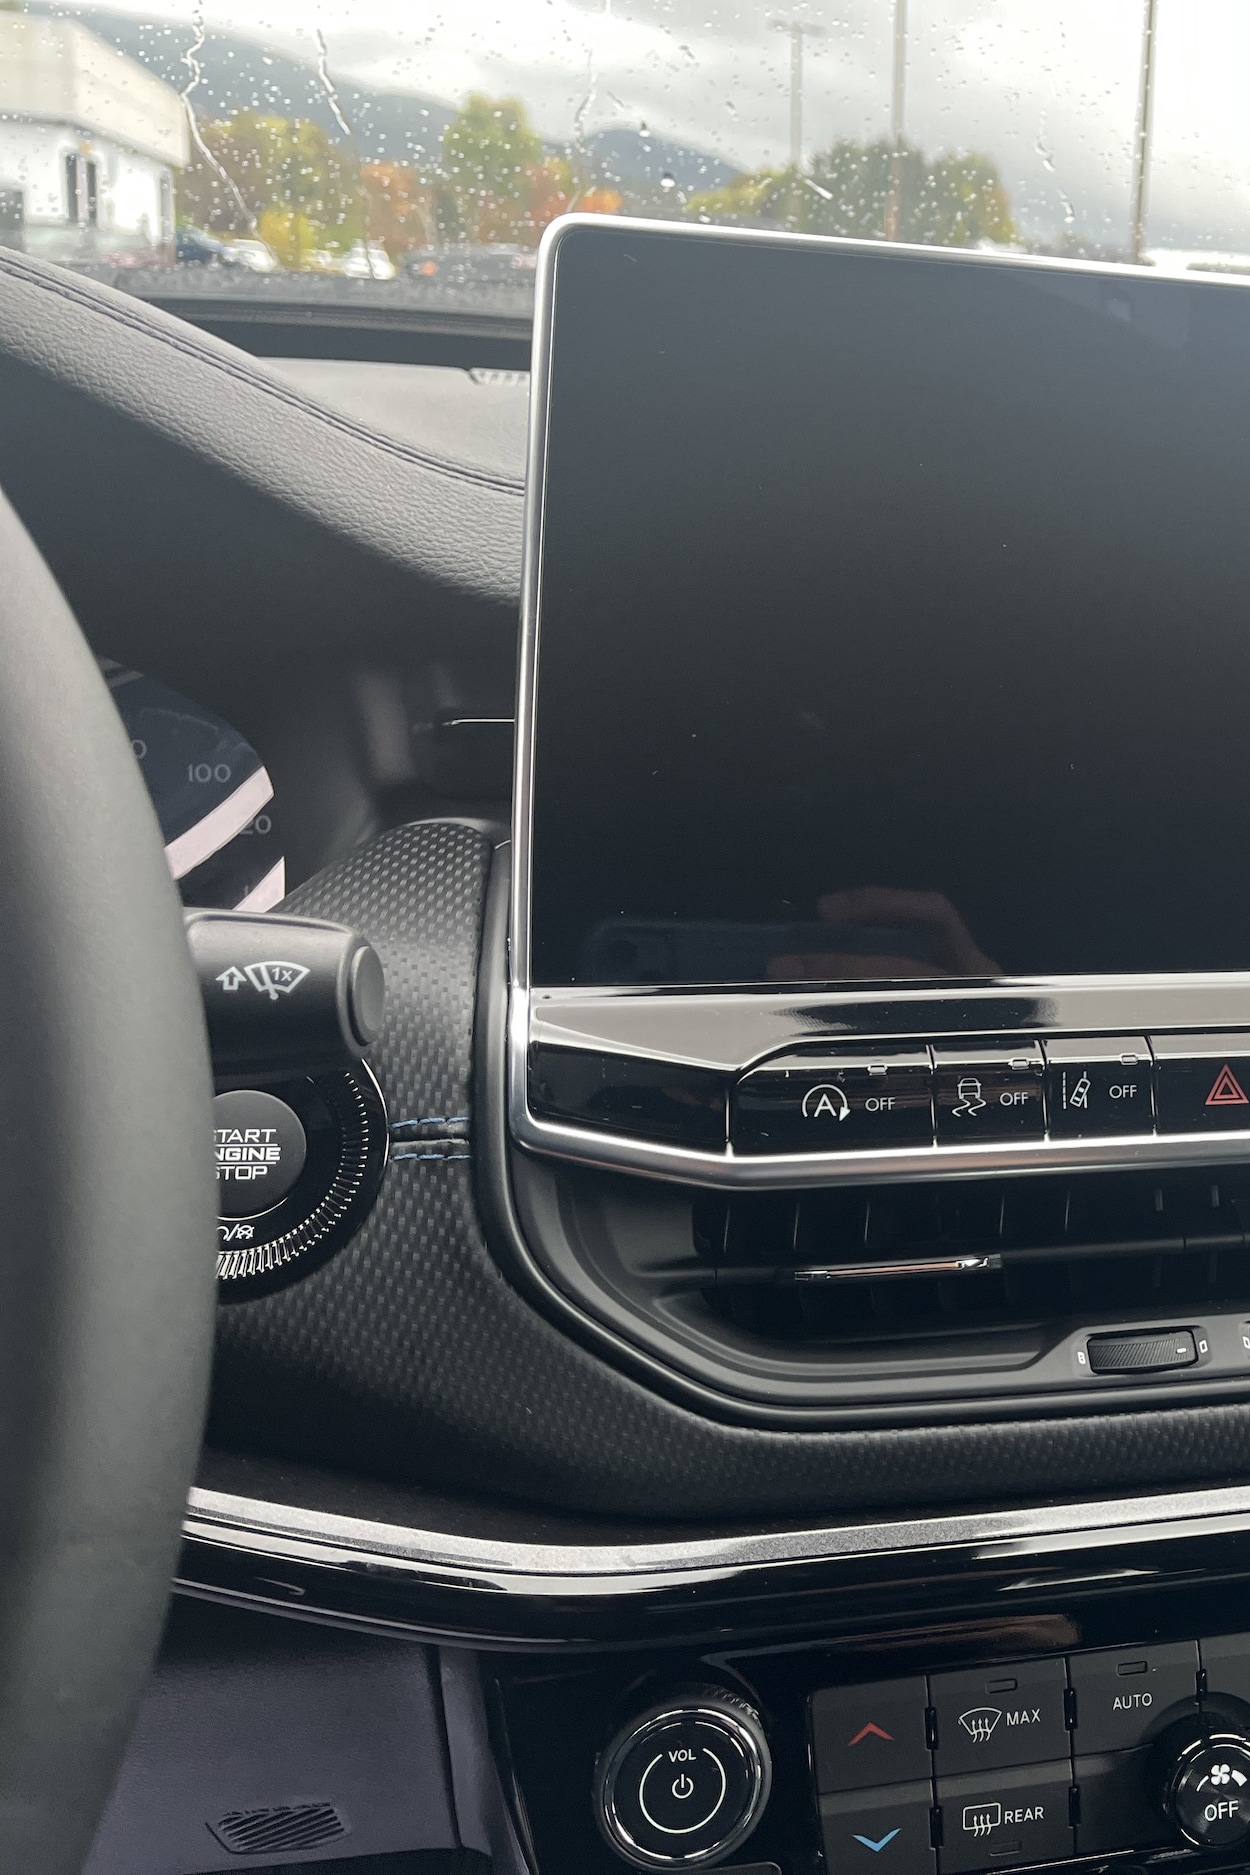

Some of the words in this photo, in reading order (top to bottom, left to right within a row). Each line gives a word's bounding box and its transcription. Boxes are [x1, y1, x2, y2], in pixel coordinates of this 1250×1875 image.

[188, 763, 231, 783] 100
[999, 1091, 1029, 1107] OFF
[1109, 1084, 1138, 1099] OFF
[865, 1096, 896, 1112] OFF
[214, 1147, 281, 1161] NGINE
[1112, 1692, 1153, 1711] AUTO
[1005, 1708, 1042, 1727] MAX
[667, 1748, 697, 1764] VOL
[1003, 1805, 1044, 1825] REAR
[1203, 1800, 1240, 1823] OFF
